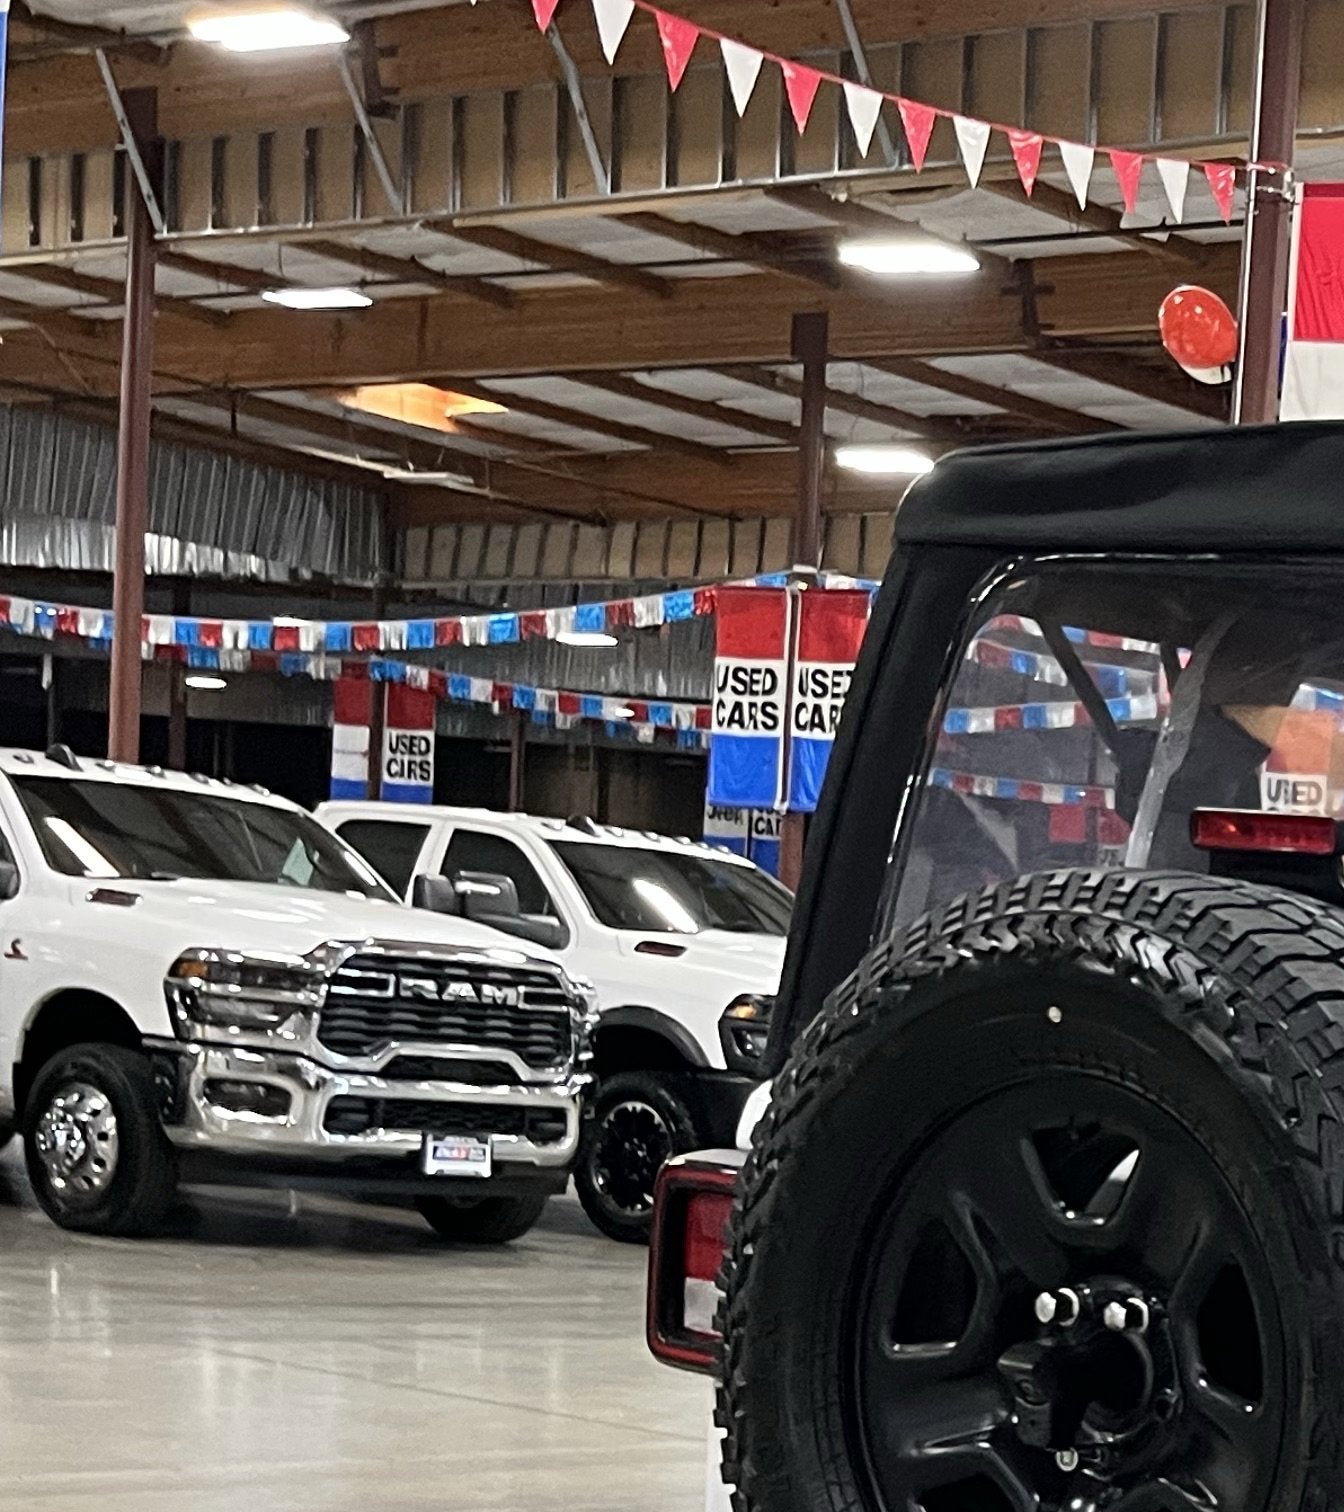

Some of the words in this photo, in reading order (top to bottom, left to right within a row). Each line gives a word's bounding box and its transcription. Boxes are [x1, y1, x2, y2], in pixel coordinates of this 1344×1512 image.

[716, 665, 779, 697] USED
[715, 698, 780, 731] CARS
[794, 701, 838, 733] CAR
[388, 732, 432, 756] USED
[754, 816, 781, 836] CA
[399, 977, 518, 1006] RAM
